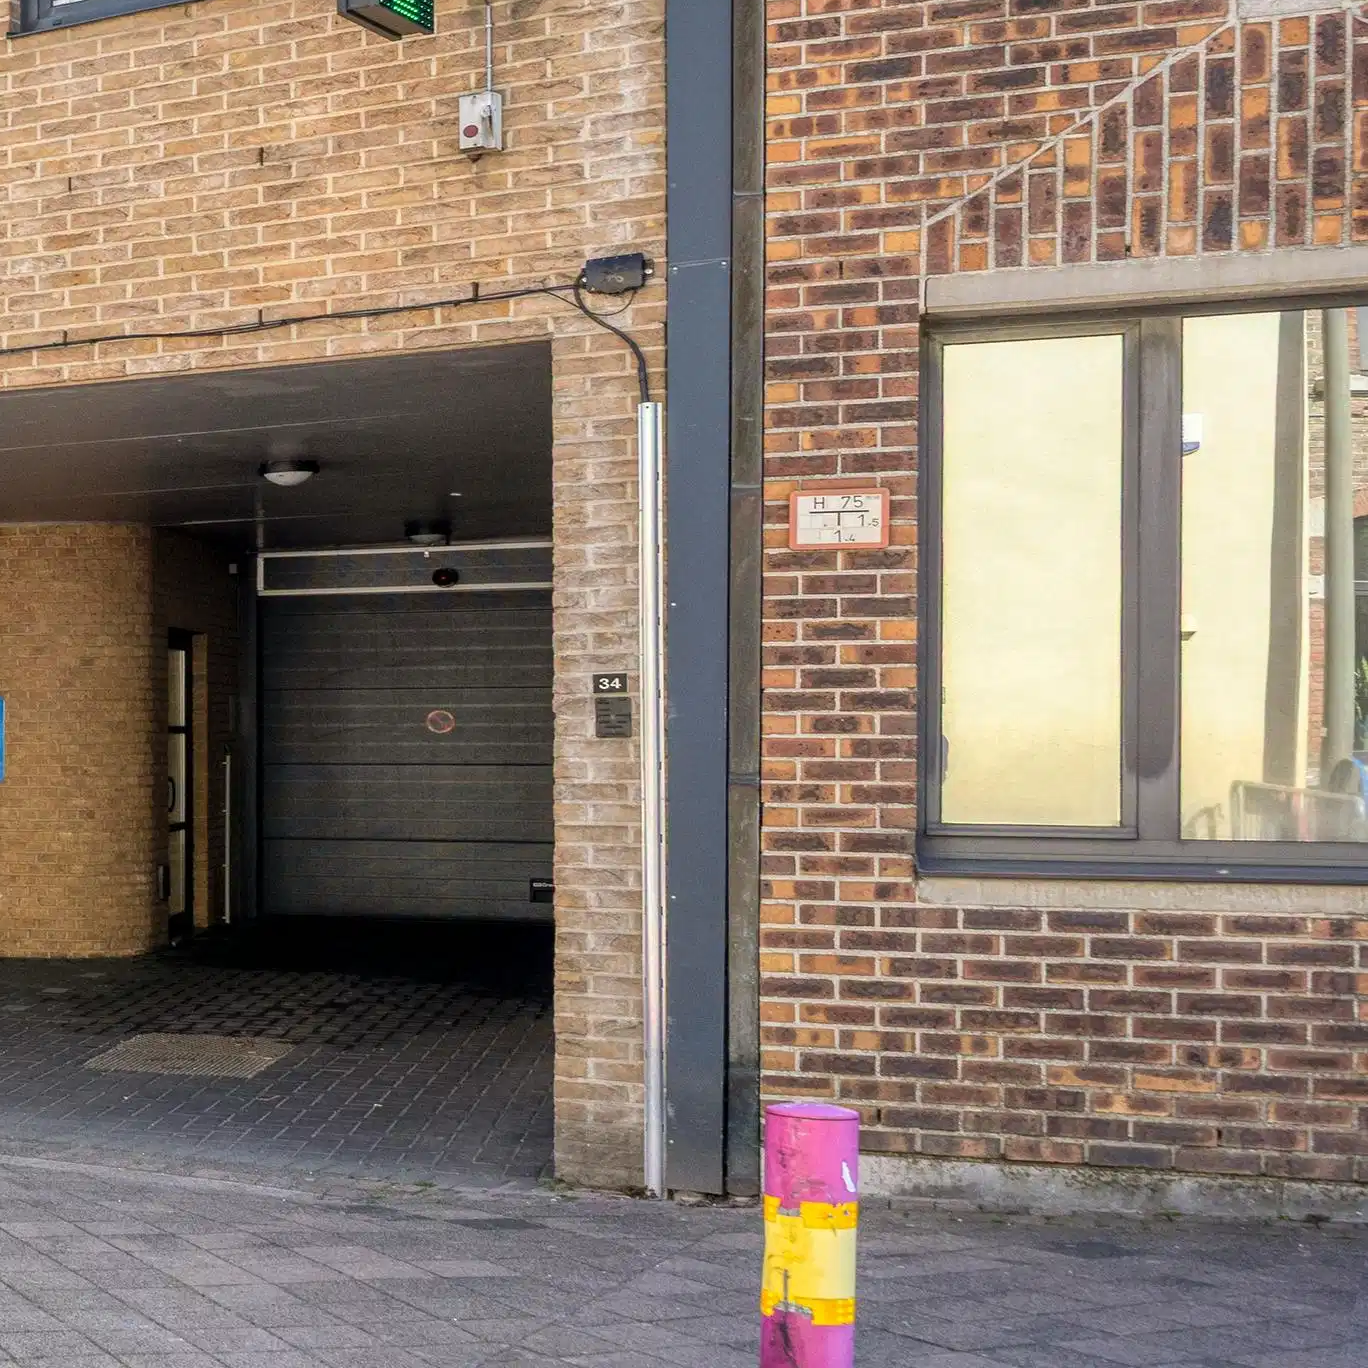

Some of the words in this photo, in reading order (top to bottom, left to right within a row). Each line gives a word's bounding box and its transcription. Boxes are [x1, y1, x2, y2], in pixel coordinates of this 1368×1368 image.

[813, 497, 825, 509] H
[841, 495, 864, 509] 75
[598, 677, 622, 690] 34
